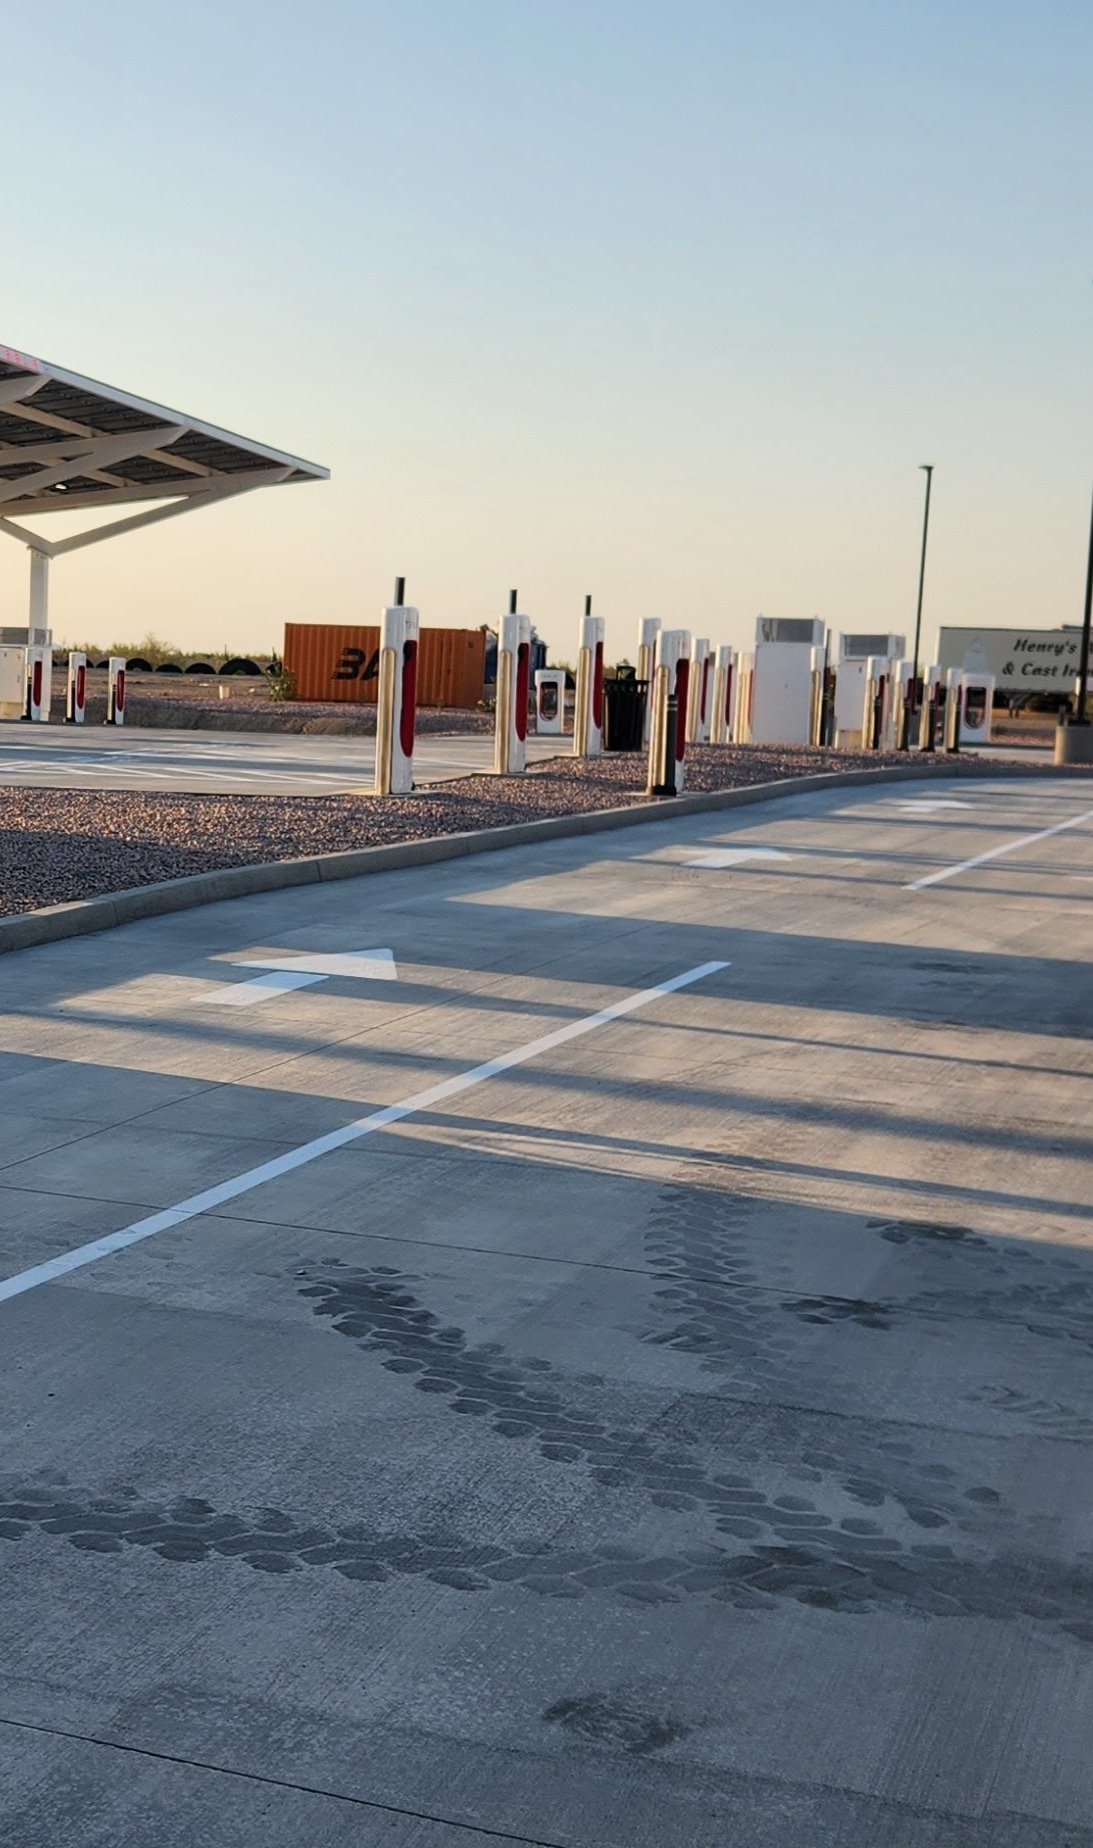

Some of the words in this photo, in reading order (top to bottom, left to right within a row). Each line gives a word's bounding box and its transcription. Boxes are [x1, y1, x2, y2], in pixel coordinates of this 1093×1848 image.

[1013, 639, 1077, 656] Henry's
[1002, 662, 1014, 675] &
[1021, 662, 1058, 677] Cast
